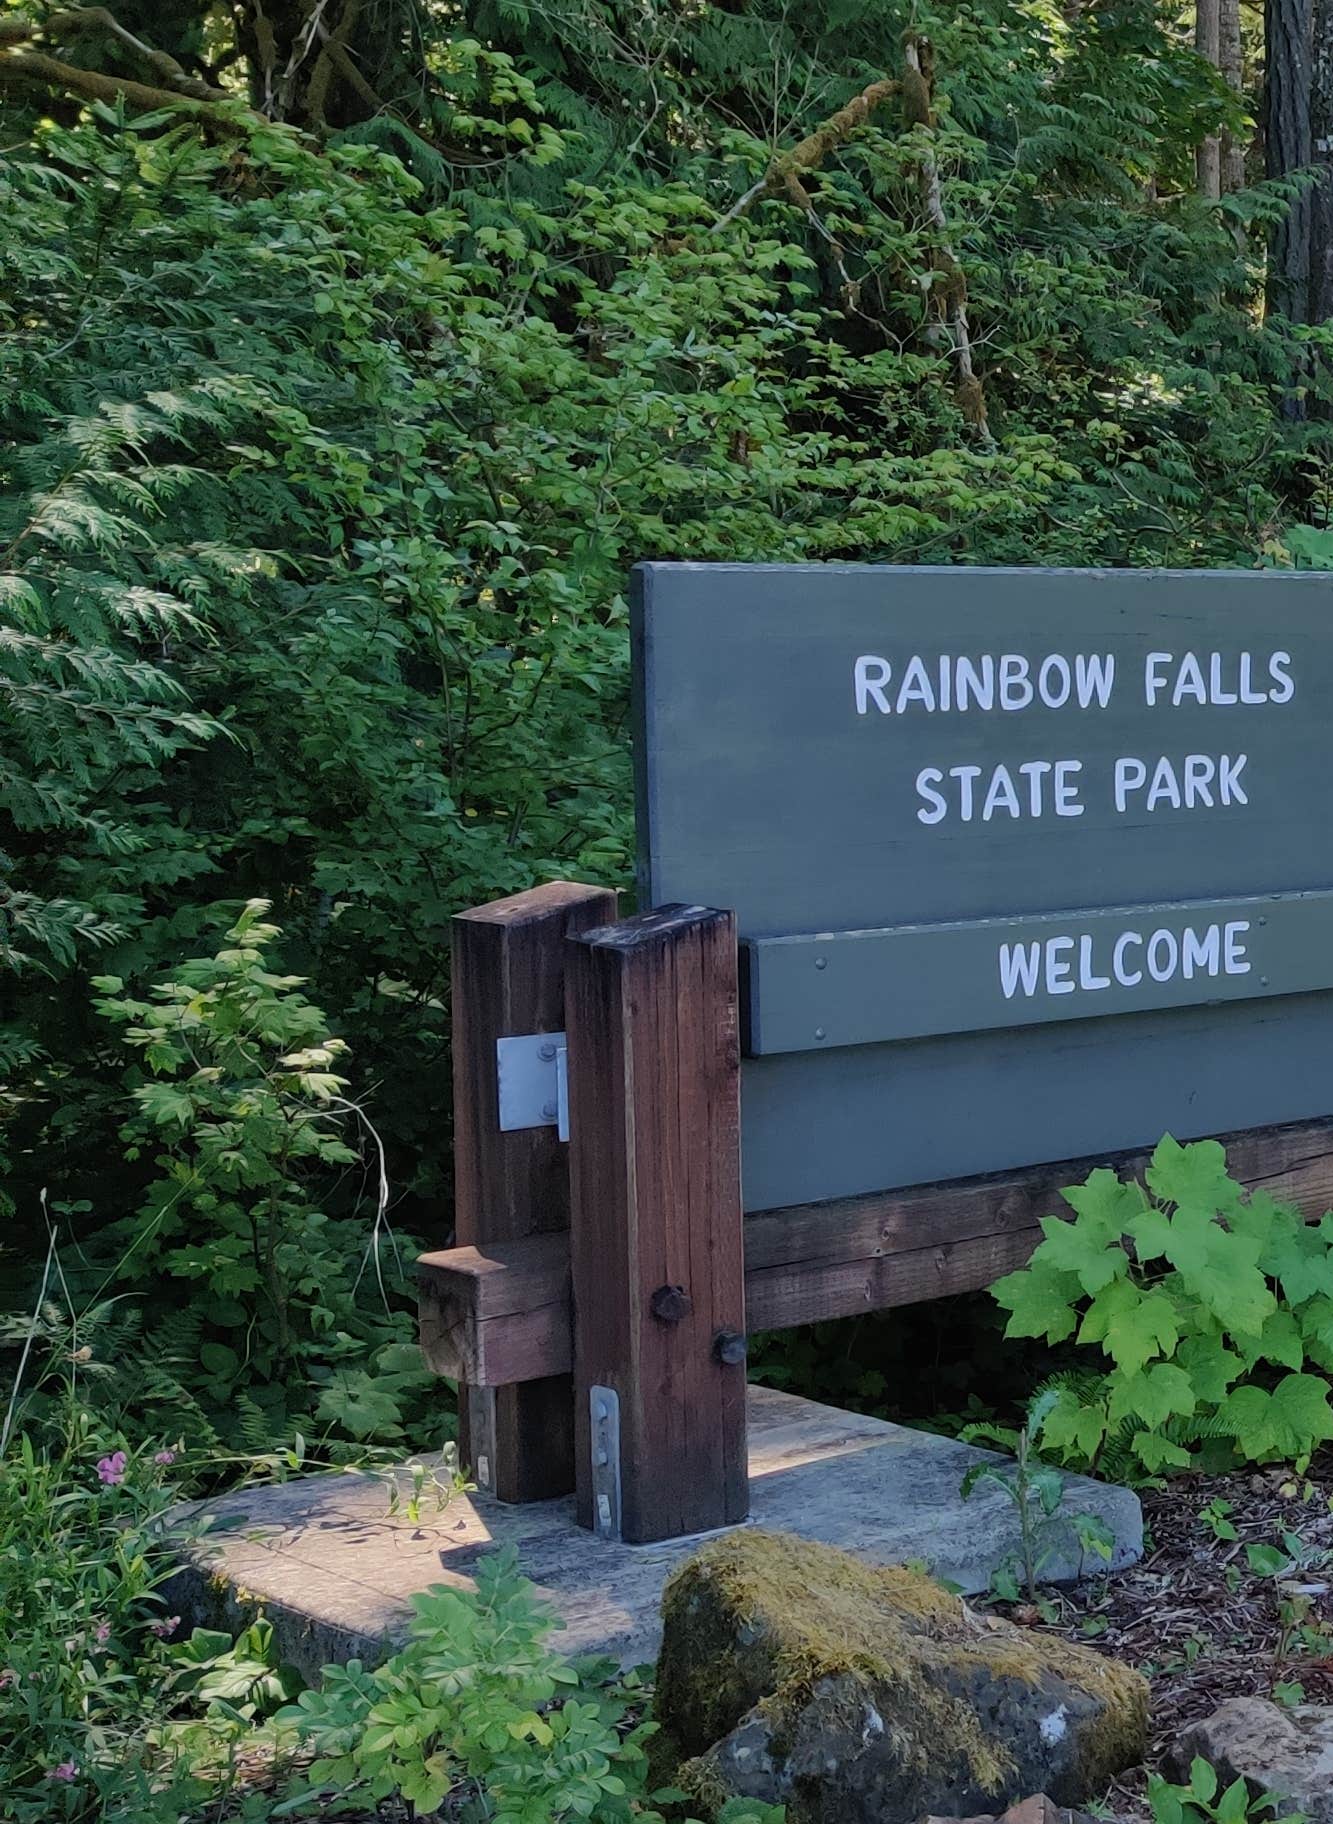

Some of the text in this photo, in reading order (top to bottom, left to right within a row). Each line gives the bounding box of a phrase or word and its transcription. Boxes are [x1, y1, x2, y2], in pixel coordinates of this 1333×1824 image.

[854, 651, 1295, 714] RAINBOW FALLS
[915, 754, 1248, 824] STATE PARK
[1000, 921, 1251, 998] WELCOME
